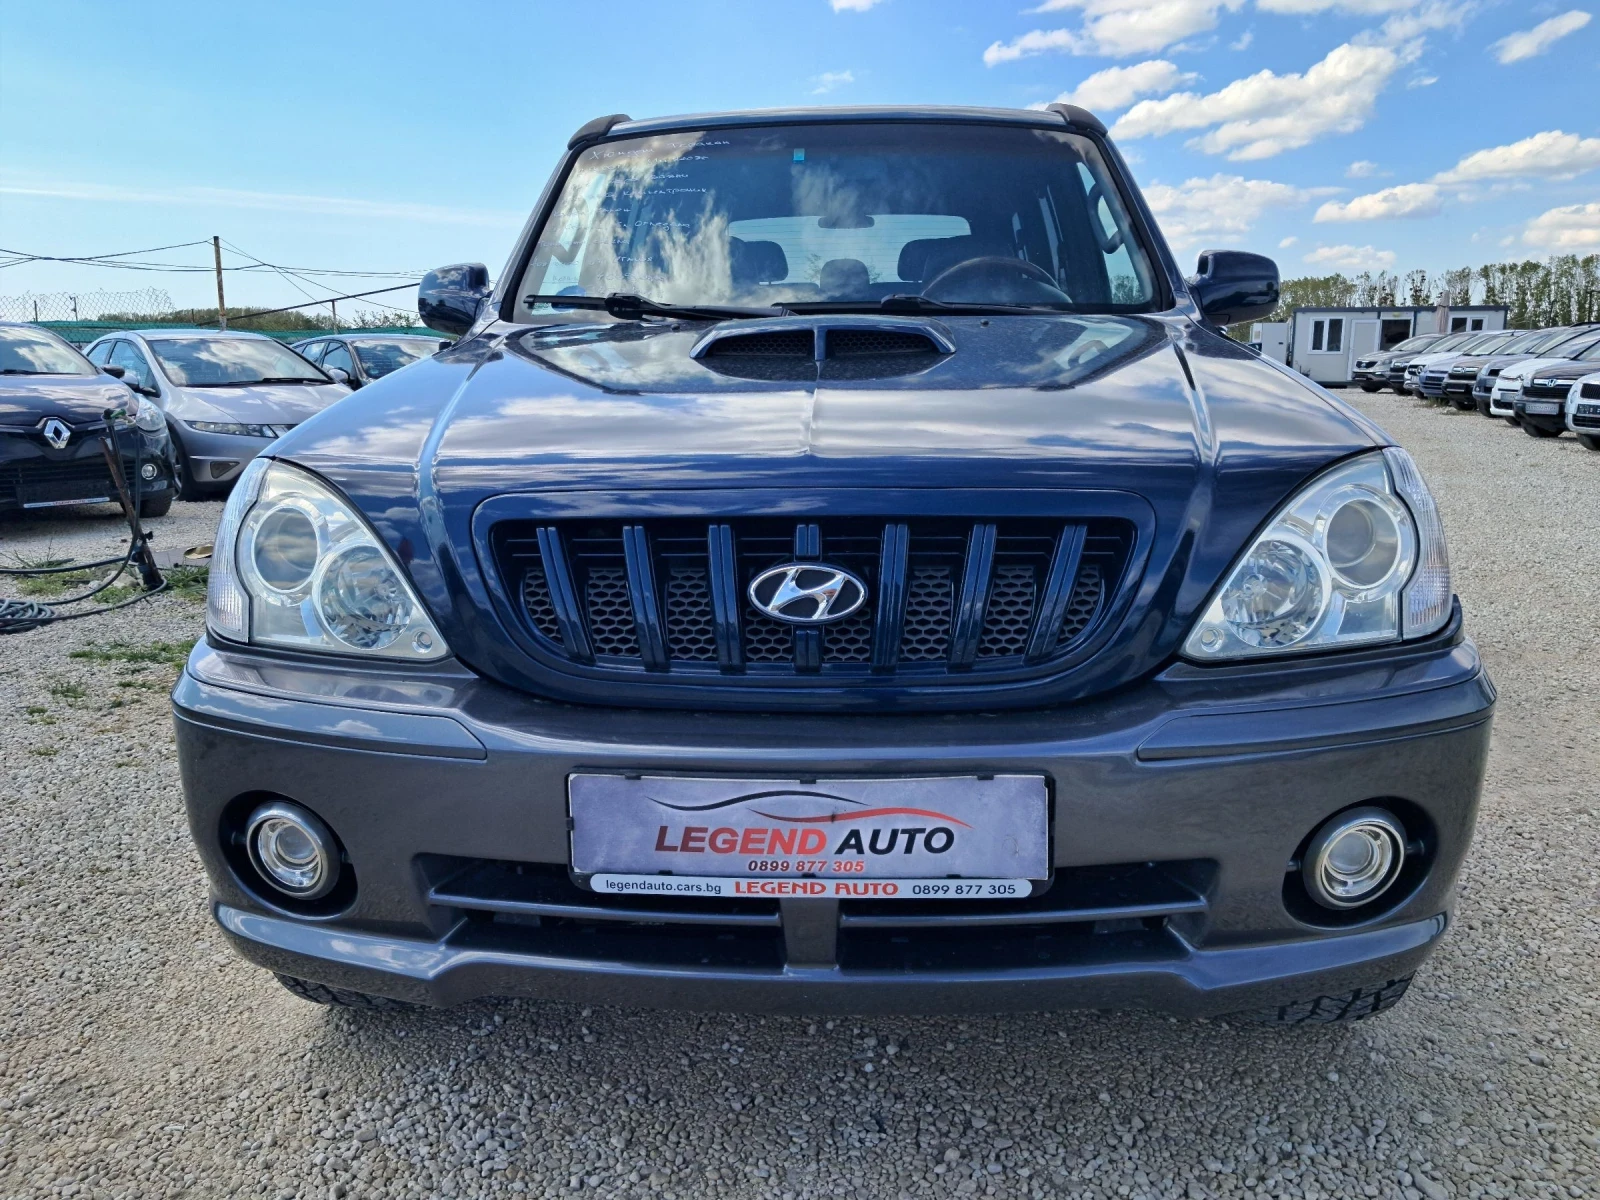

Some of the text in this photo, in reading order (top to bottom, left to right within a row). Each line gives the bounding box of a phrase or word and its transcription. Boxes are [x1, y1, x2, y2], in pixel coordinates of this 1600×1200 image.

[655, 825, 955, 856] LEGEND AUTO
[748, 860, 865, 872] 0899 877 305
[605, 879, 1016, 896] legendauto.cars.bg LEGEND AUTO 0899 877 305
